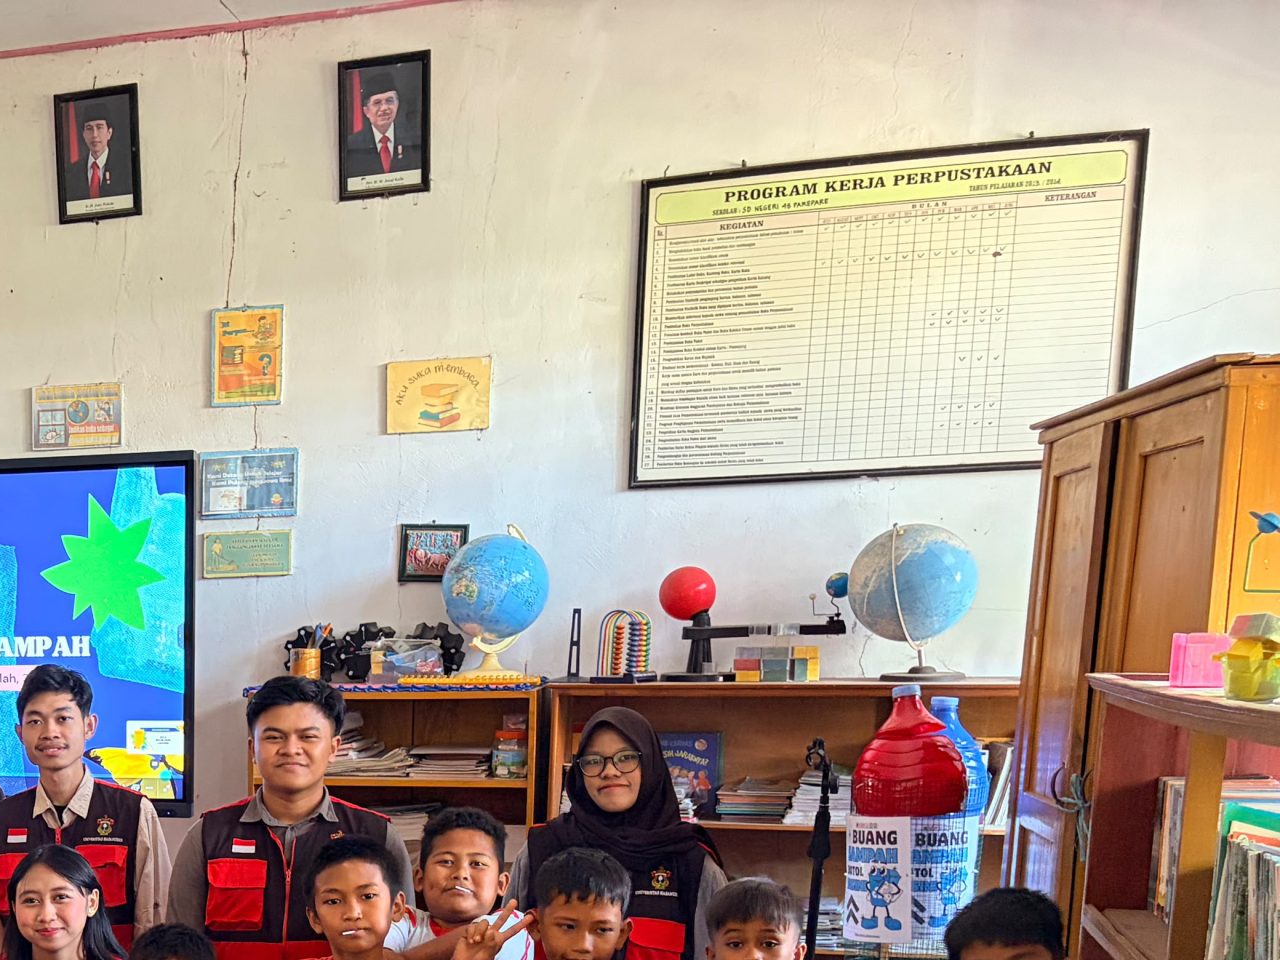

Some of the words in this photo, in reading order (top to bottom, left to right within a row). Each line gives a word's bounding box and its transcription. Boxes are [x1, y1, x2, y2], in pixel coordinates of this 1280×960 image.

[724, 182, 817, 203] PROGRAM
[825, 176, 885, 193] KERJA
[893, 161, 1052, 187] PERPUSTAKAAN
[1045, 191, 1097, 202] KETERANGAN
[755, 203, 779, 212] NEGERI
[793, 198, 829, 208] PAREPARE
[720, 220, 764, 231] KEGIATAN
[852, 829, 898, 845] BUANG
[915, 831, 968, 847] BUANG
[848, 846, 898, 864] AMPAH
[912, 847, 968, 864] AMPAH
[848, 865, 864, 877] TOL
